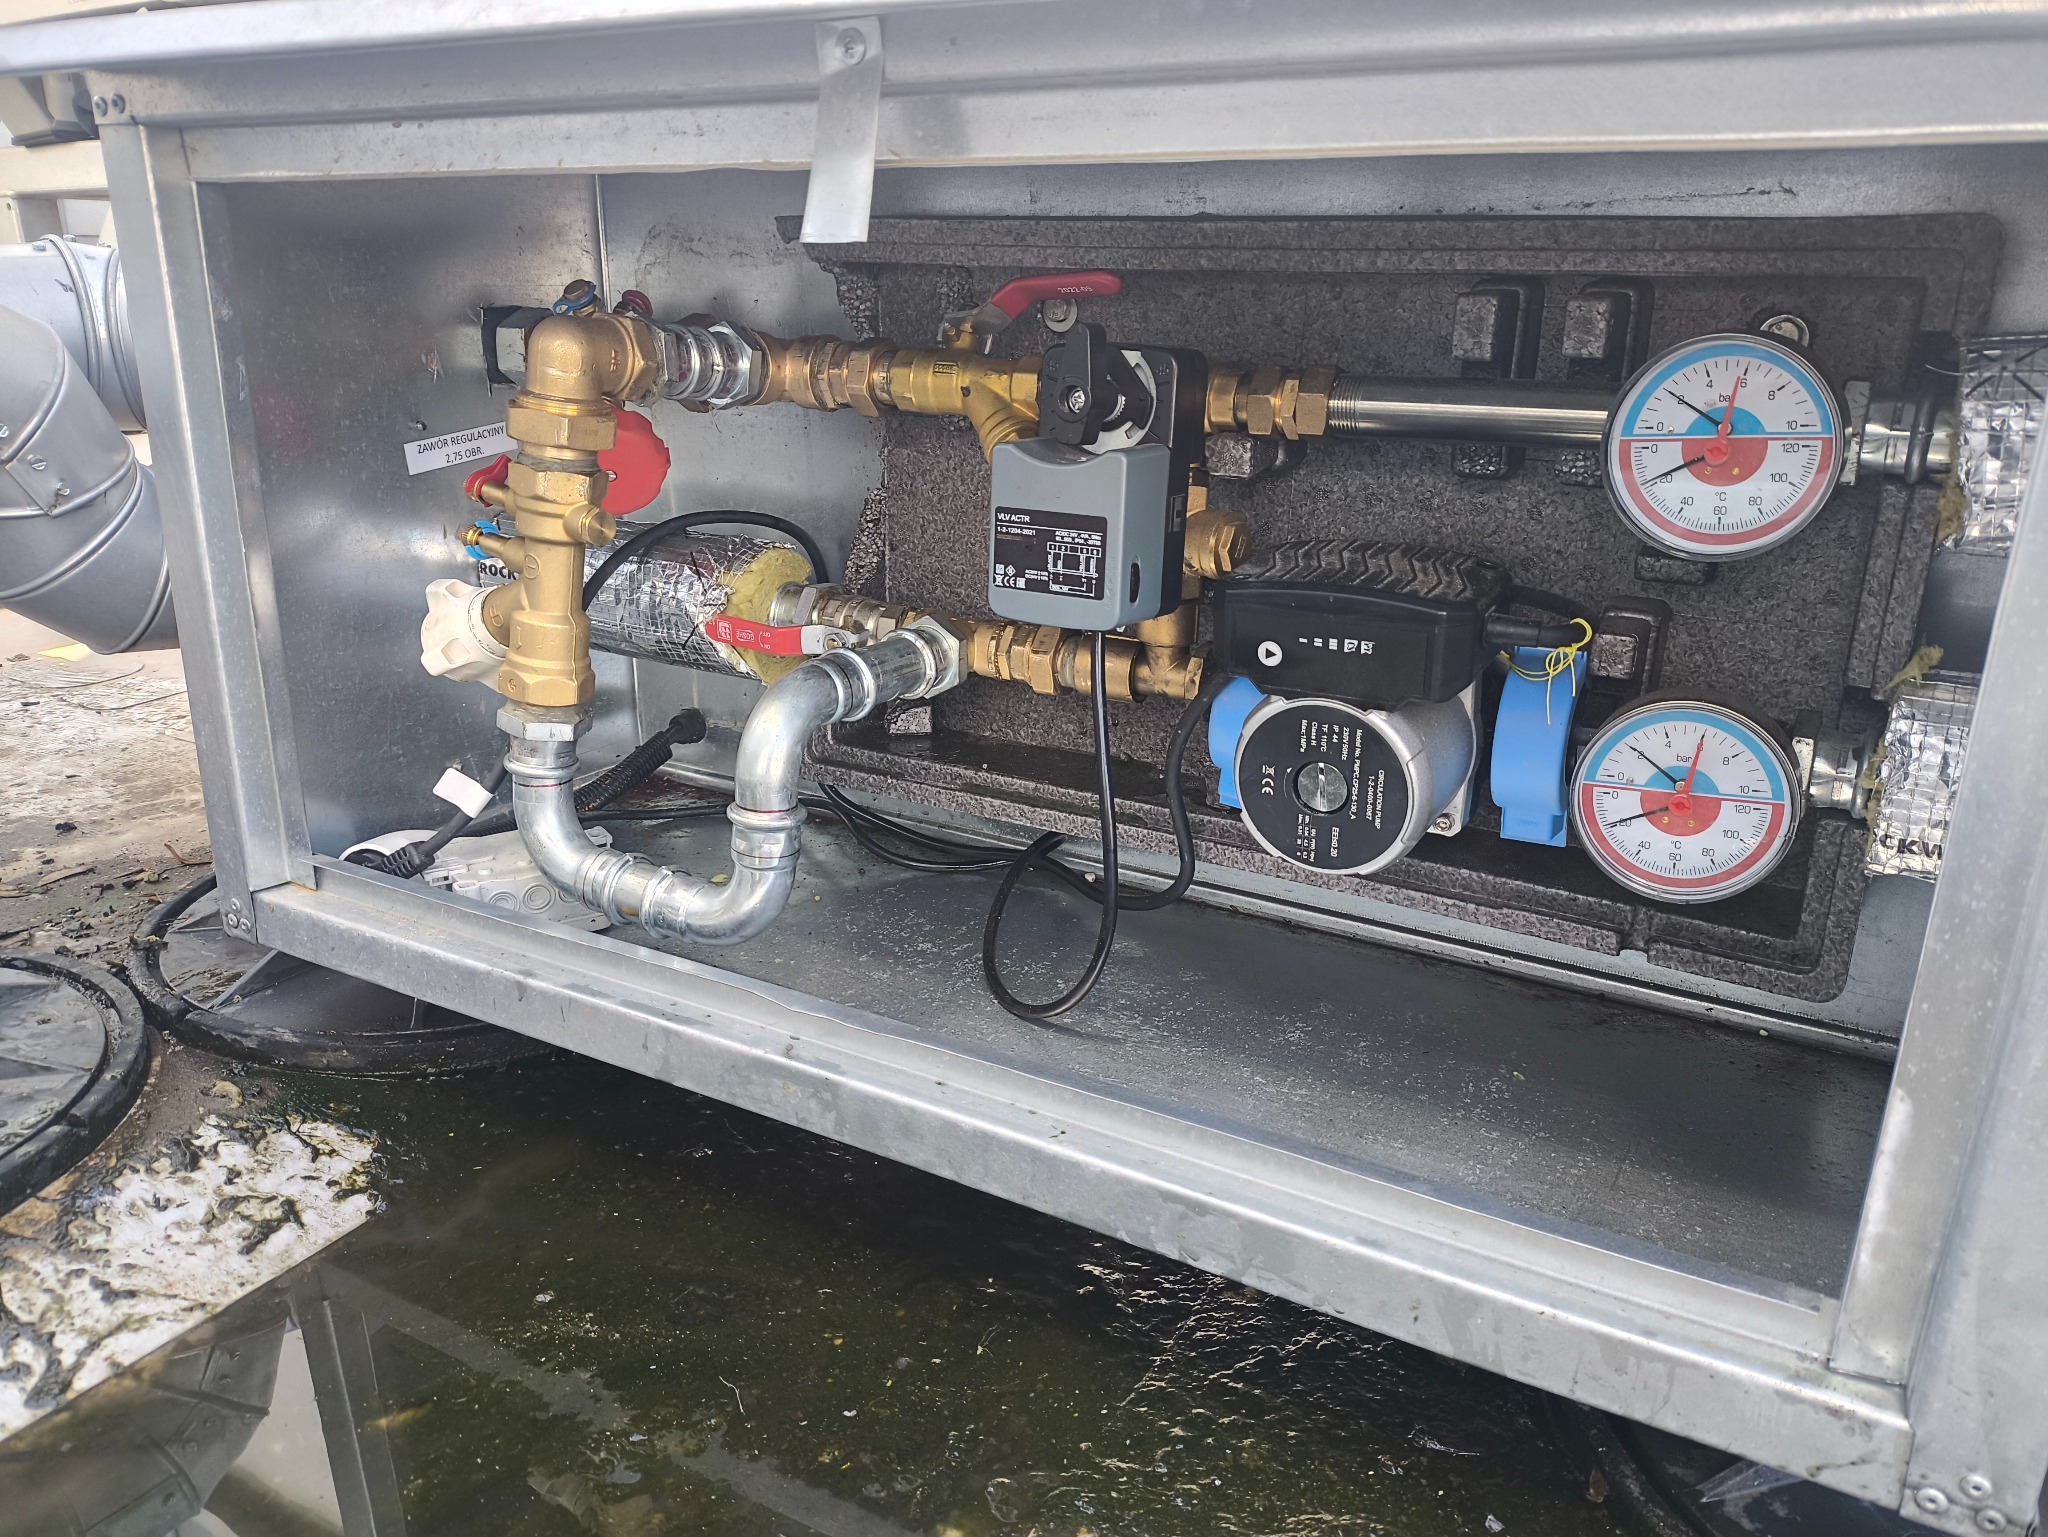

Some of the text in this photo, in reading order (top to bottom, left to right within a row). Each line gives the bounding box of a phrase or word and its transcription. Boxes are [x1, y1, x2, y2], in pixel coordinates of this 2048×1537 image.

[1706, 379, 1713, 389] 4
[1740, 378, 1747, 388] 6
[1678, 395, 1684, 405] 2
[1719, 393, 1731, 403] ba
[1768, 391, 1775, 400] 8
[1657, 422, 1664, 432] 0
[1786, 420, 1798, 430] 10
[417, 425, 505, 454] ZAWÓR REGULACYJNY
[1651, 444, 1658, 453] 0
[1781, 443, 1800, 453] 120
[446, 446, 484, 464] 2,75 OBR.
[1660, 473, 1673, 484] 20
[1770, 473, 1788, 483] 100
[1680, 496, 1694, 506] 40
[1748, 496, 1762, 506] 80
[1714, 506, 1727, 516] 60
[997, 513, 1030, 523] VLV ACTR
[997, 526, 1036, 536] 1-2-1204-2021
[1664, 740, 1672, 749] 4
[1637, 750, 1644, 760] 2
[1676, 754, 1693, 763] bar
[1723, 756, 1730, 766] 8
[1618, 772, 1625, 781] 0
[1262, 778, 1274, 796] CE
[1739, 785, 1749, 794] 10
[1374, 770, 1385, 829] CIRCULATION PUMP
[1612, 791, 1619, 799] 0
[1734, 805, 1751, 814] 120
[1722, 830, 1740, 839] 100
[1638, 840, 1651, 850] 40
[1668, 853, 1682, 862] 60
[1702, 848, 1715, 857] 80
